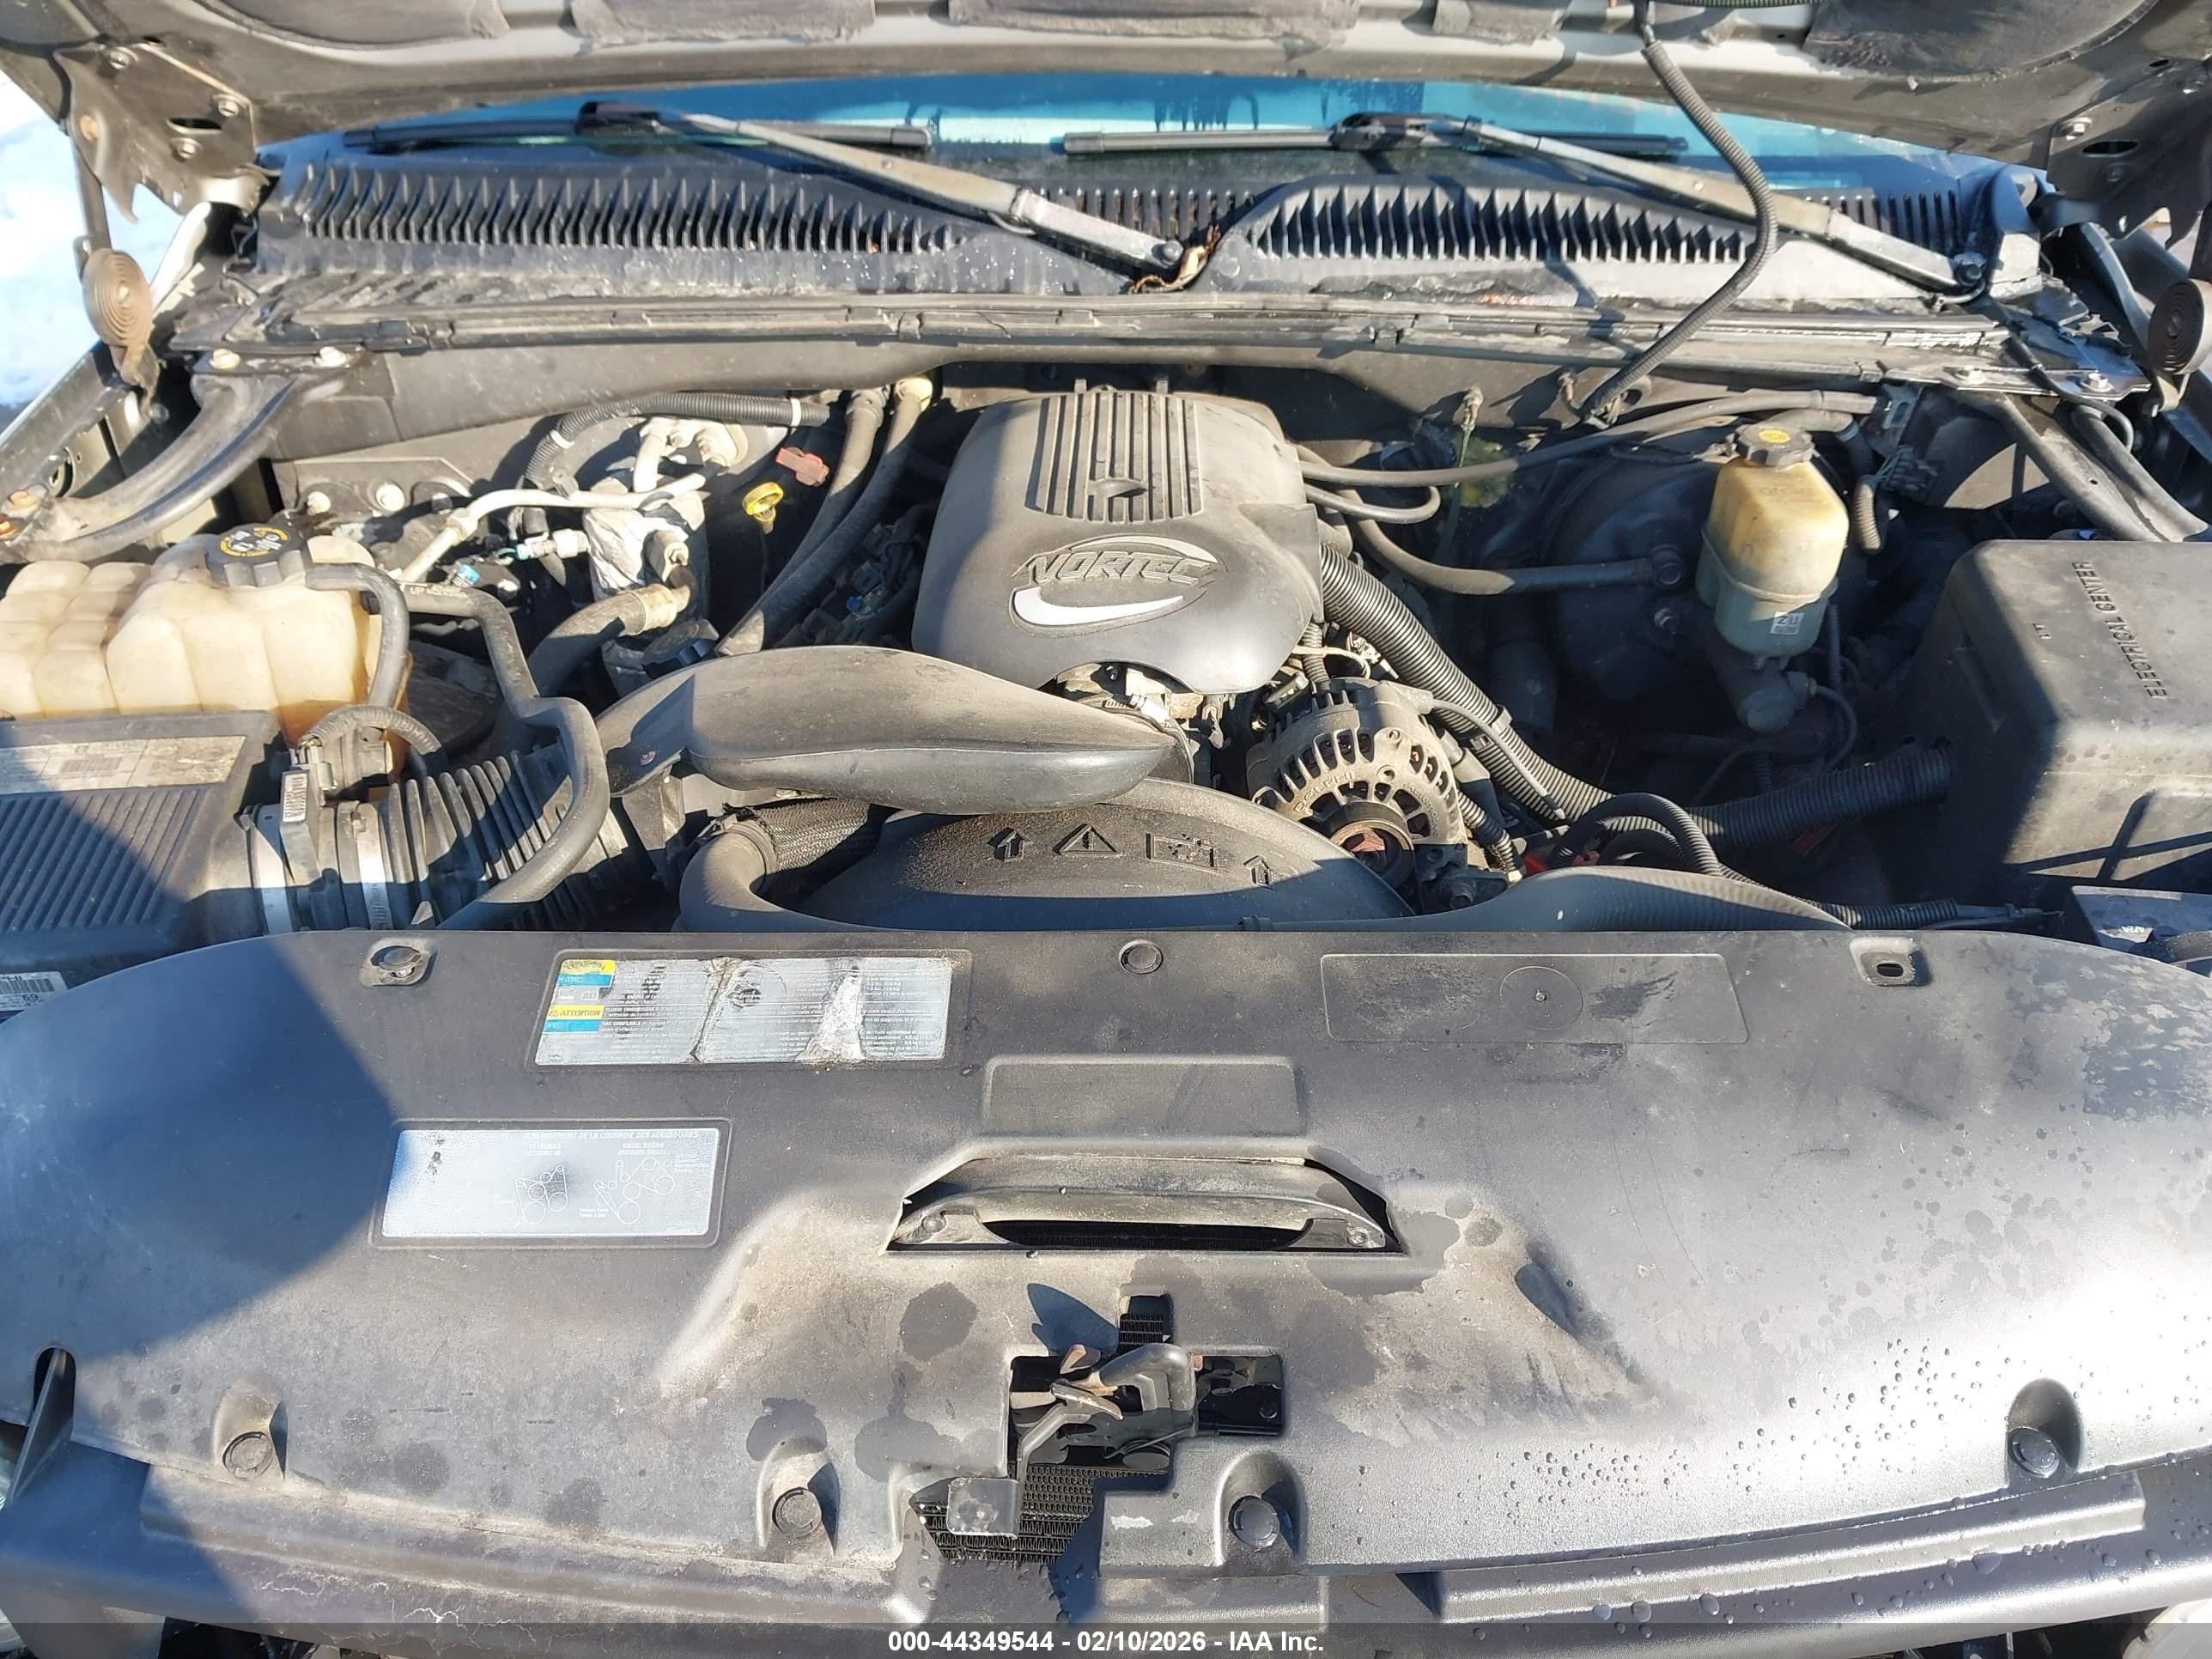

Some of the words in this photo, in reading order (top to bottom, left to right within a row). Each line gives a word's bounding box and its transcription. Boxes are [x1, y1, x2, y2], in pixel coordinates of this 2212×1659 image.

[1028, 550, 1211, 586] VORTEC
[2070, 561, 2118, 613] CENTER
[2104, 617, 2169, 700] ELECTRICAL
